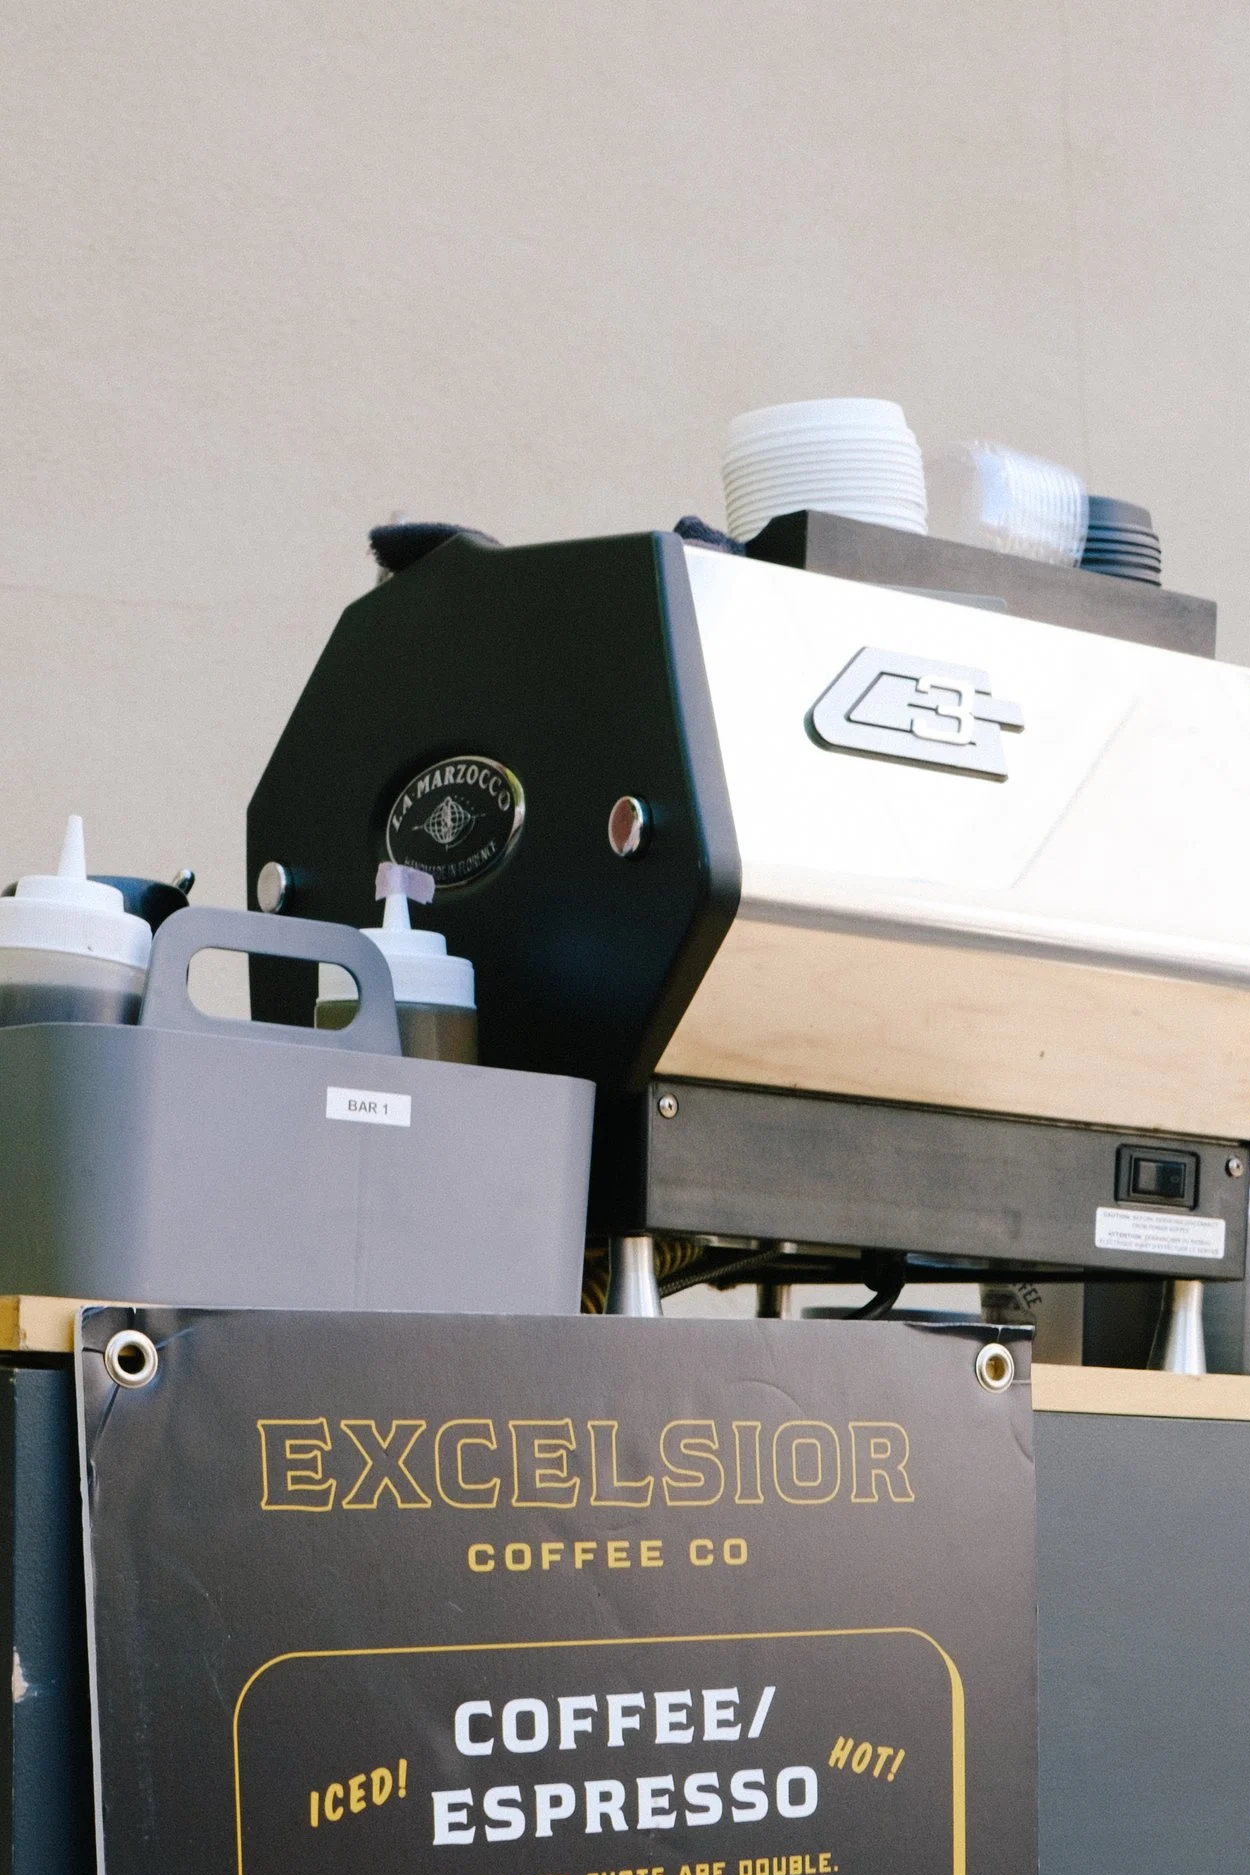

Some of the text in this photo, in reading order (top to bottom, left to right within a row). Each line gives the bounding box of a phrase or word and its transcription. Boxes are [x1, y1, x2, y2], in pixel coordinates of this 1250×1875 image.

[391, 764, 511, 832] LA MARZOCCO
[348, 1099, 389, 1115] BAR 1
[256, 1417, 916, 1512] EXCELSIOR
[467, 1537, 748, 1572] COFFEE CO
[455, 1686, 776, 1757] COFFEE/
[310, 1758, 408, 1828] ICED!
[828, 1736, 906, 1782] HOT!
[432, 1766, 819, 1846] ESPRESSO
